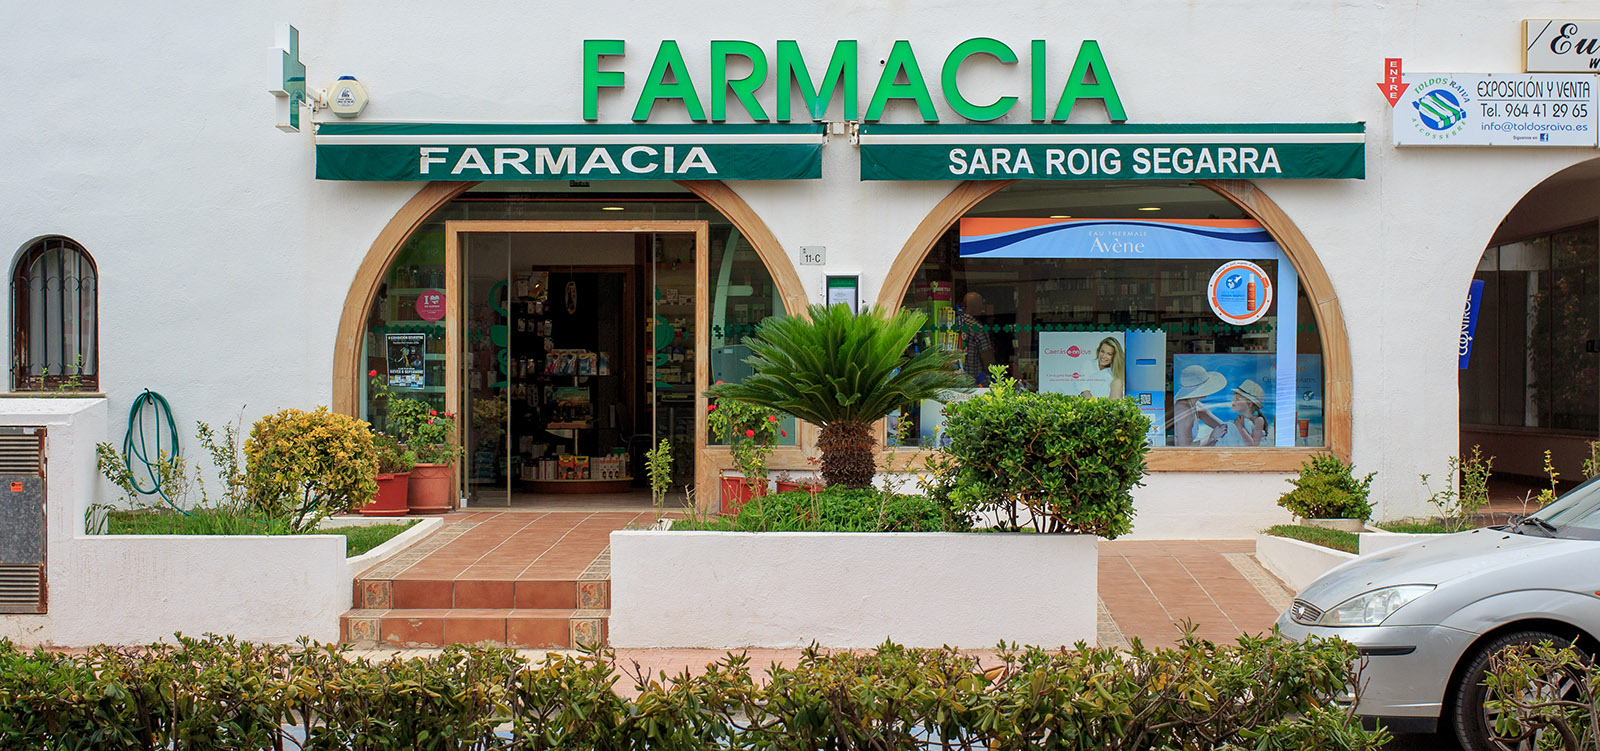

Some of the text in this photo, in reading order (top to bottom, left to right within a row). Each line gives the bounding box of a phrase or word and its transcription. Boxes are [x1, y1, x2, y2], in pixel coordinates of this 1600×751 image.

[582, 37, 1128, 123] FARMACIA
[1389, 61, 1399, 99] ENTRE
[1414, 77, 1471, 103] TOLDOS RAIVA
[1477, 76, 1590, 98] EXPOSICIÓN Y VENTA
[1481, 103, 1588, 118] Tel. 964 41 29 65
[1411, 117, 1467, 140] ALCOSSEBRE
[1481, 121, 1588, 132] info@toldosraiva.es
[419, 145, 718, 175] FARMACIA
[949, 147, 1282, 175] SARA ROIG SEGARRA
[1090, 237, 1145, 254] Avène
[805, 254, 821, 263] 11-C
